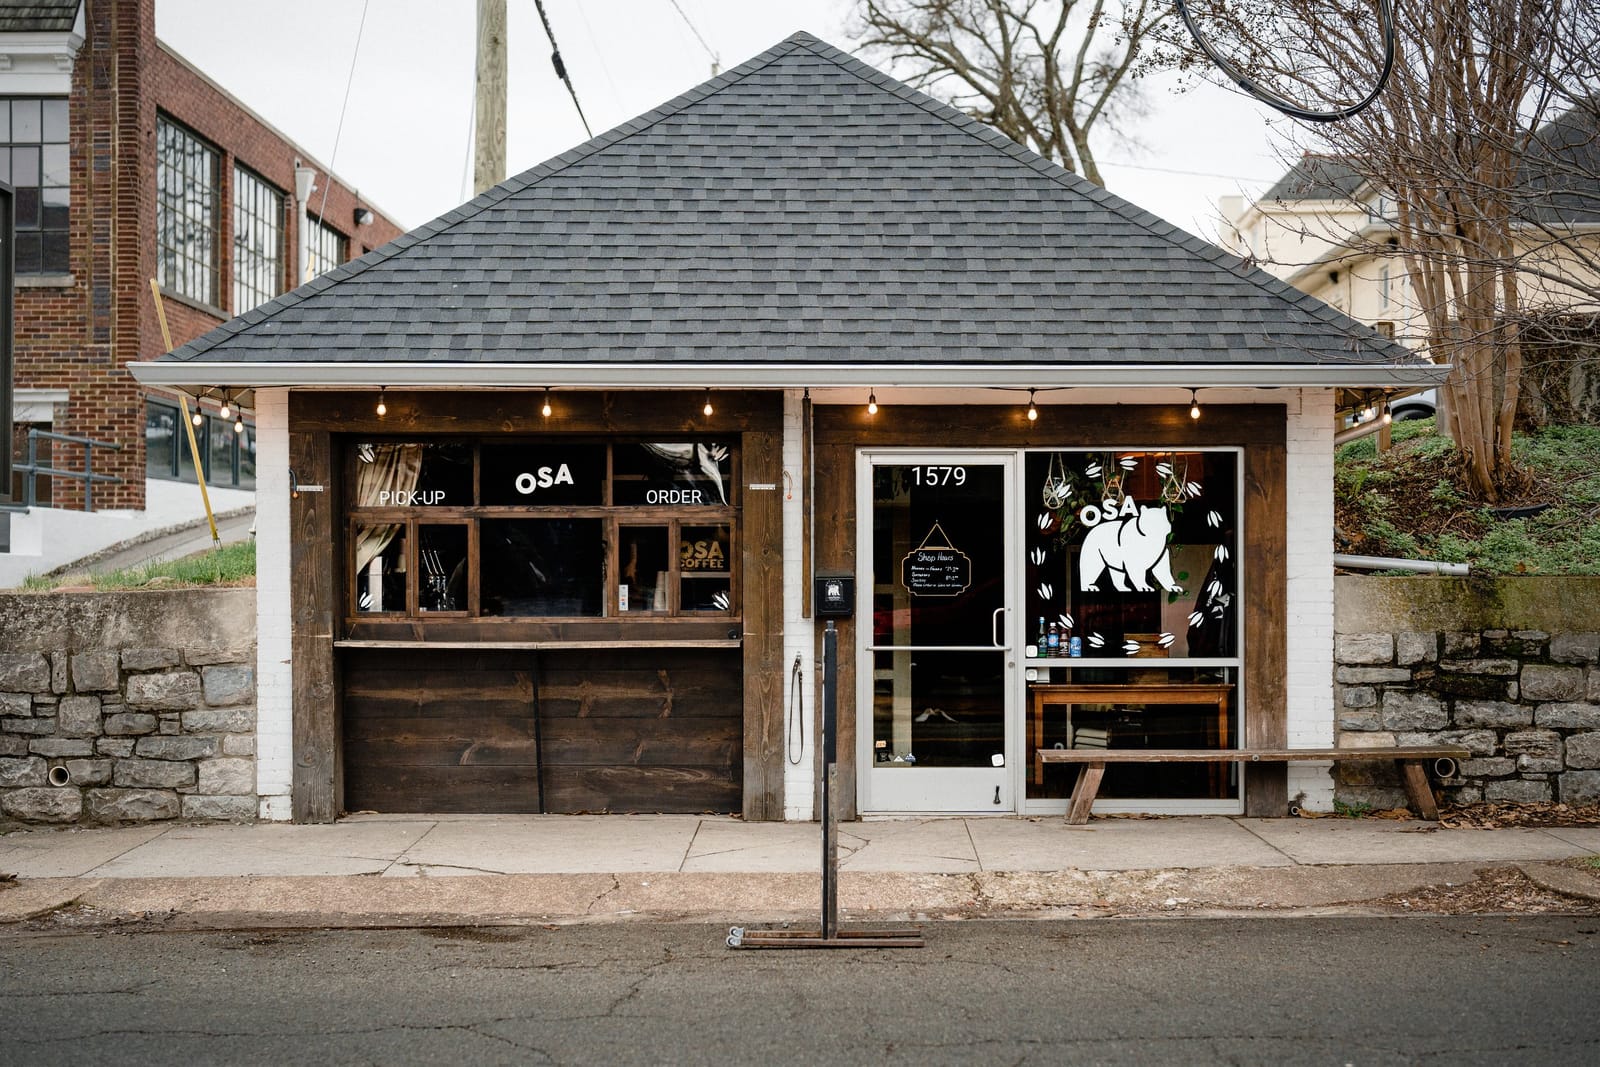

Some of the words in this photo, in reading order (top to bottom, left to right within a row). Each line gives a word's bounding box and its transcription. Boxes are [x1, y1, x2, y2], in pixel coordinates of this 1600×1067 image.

[515, 463, 574, 495] OSA
[911, 466, 967, 486] 1579
[379, 490, 447, 505] PICK-UP
[646, 489, 703, 504] ORDER
[1079, 495, 1140, 527] OSA
[680, 541, 724, 559] OSA
